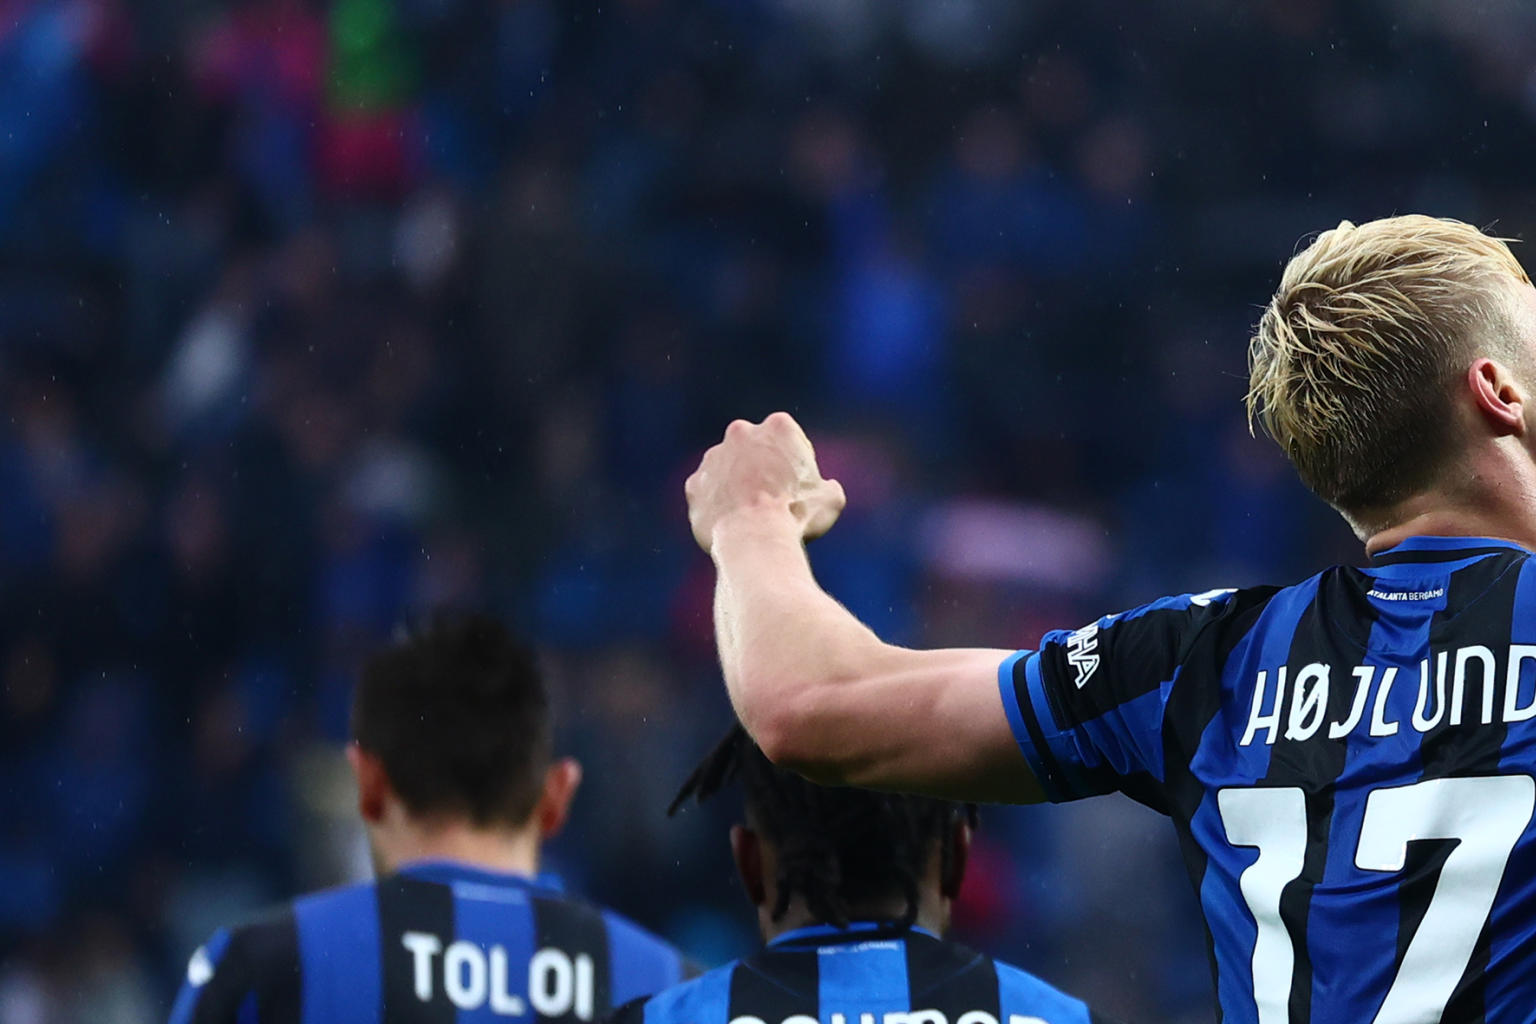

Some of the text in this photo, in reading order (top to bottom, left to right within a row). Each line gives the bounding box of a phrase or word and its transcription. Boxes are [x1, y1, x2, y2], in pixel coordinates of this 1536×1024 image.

[1366, 588, 1444, 601] ATALANTA BERGAMO
[403, 931, 595, 1020] TOLOI
